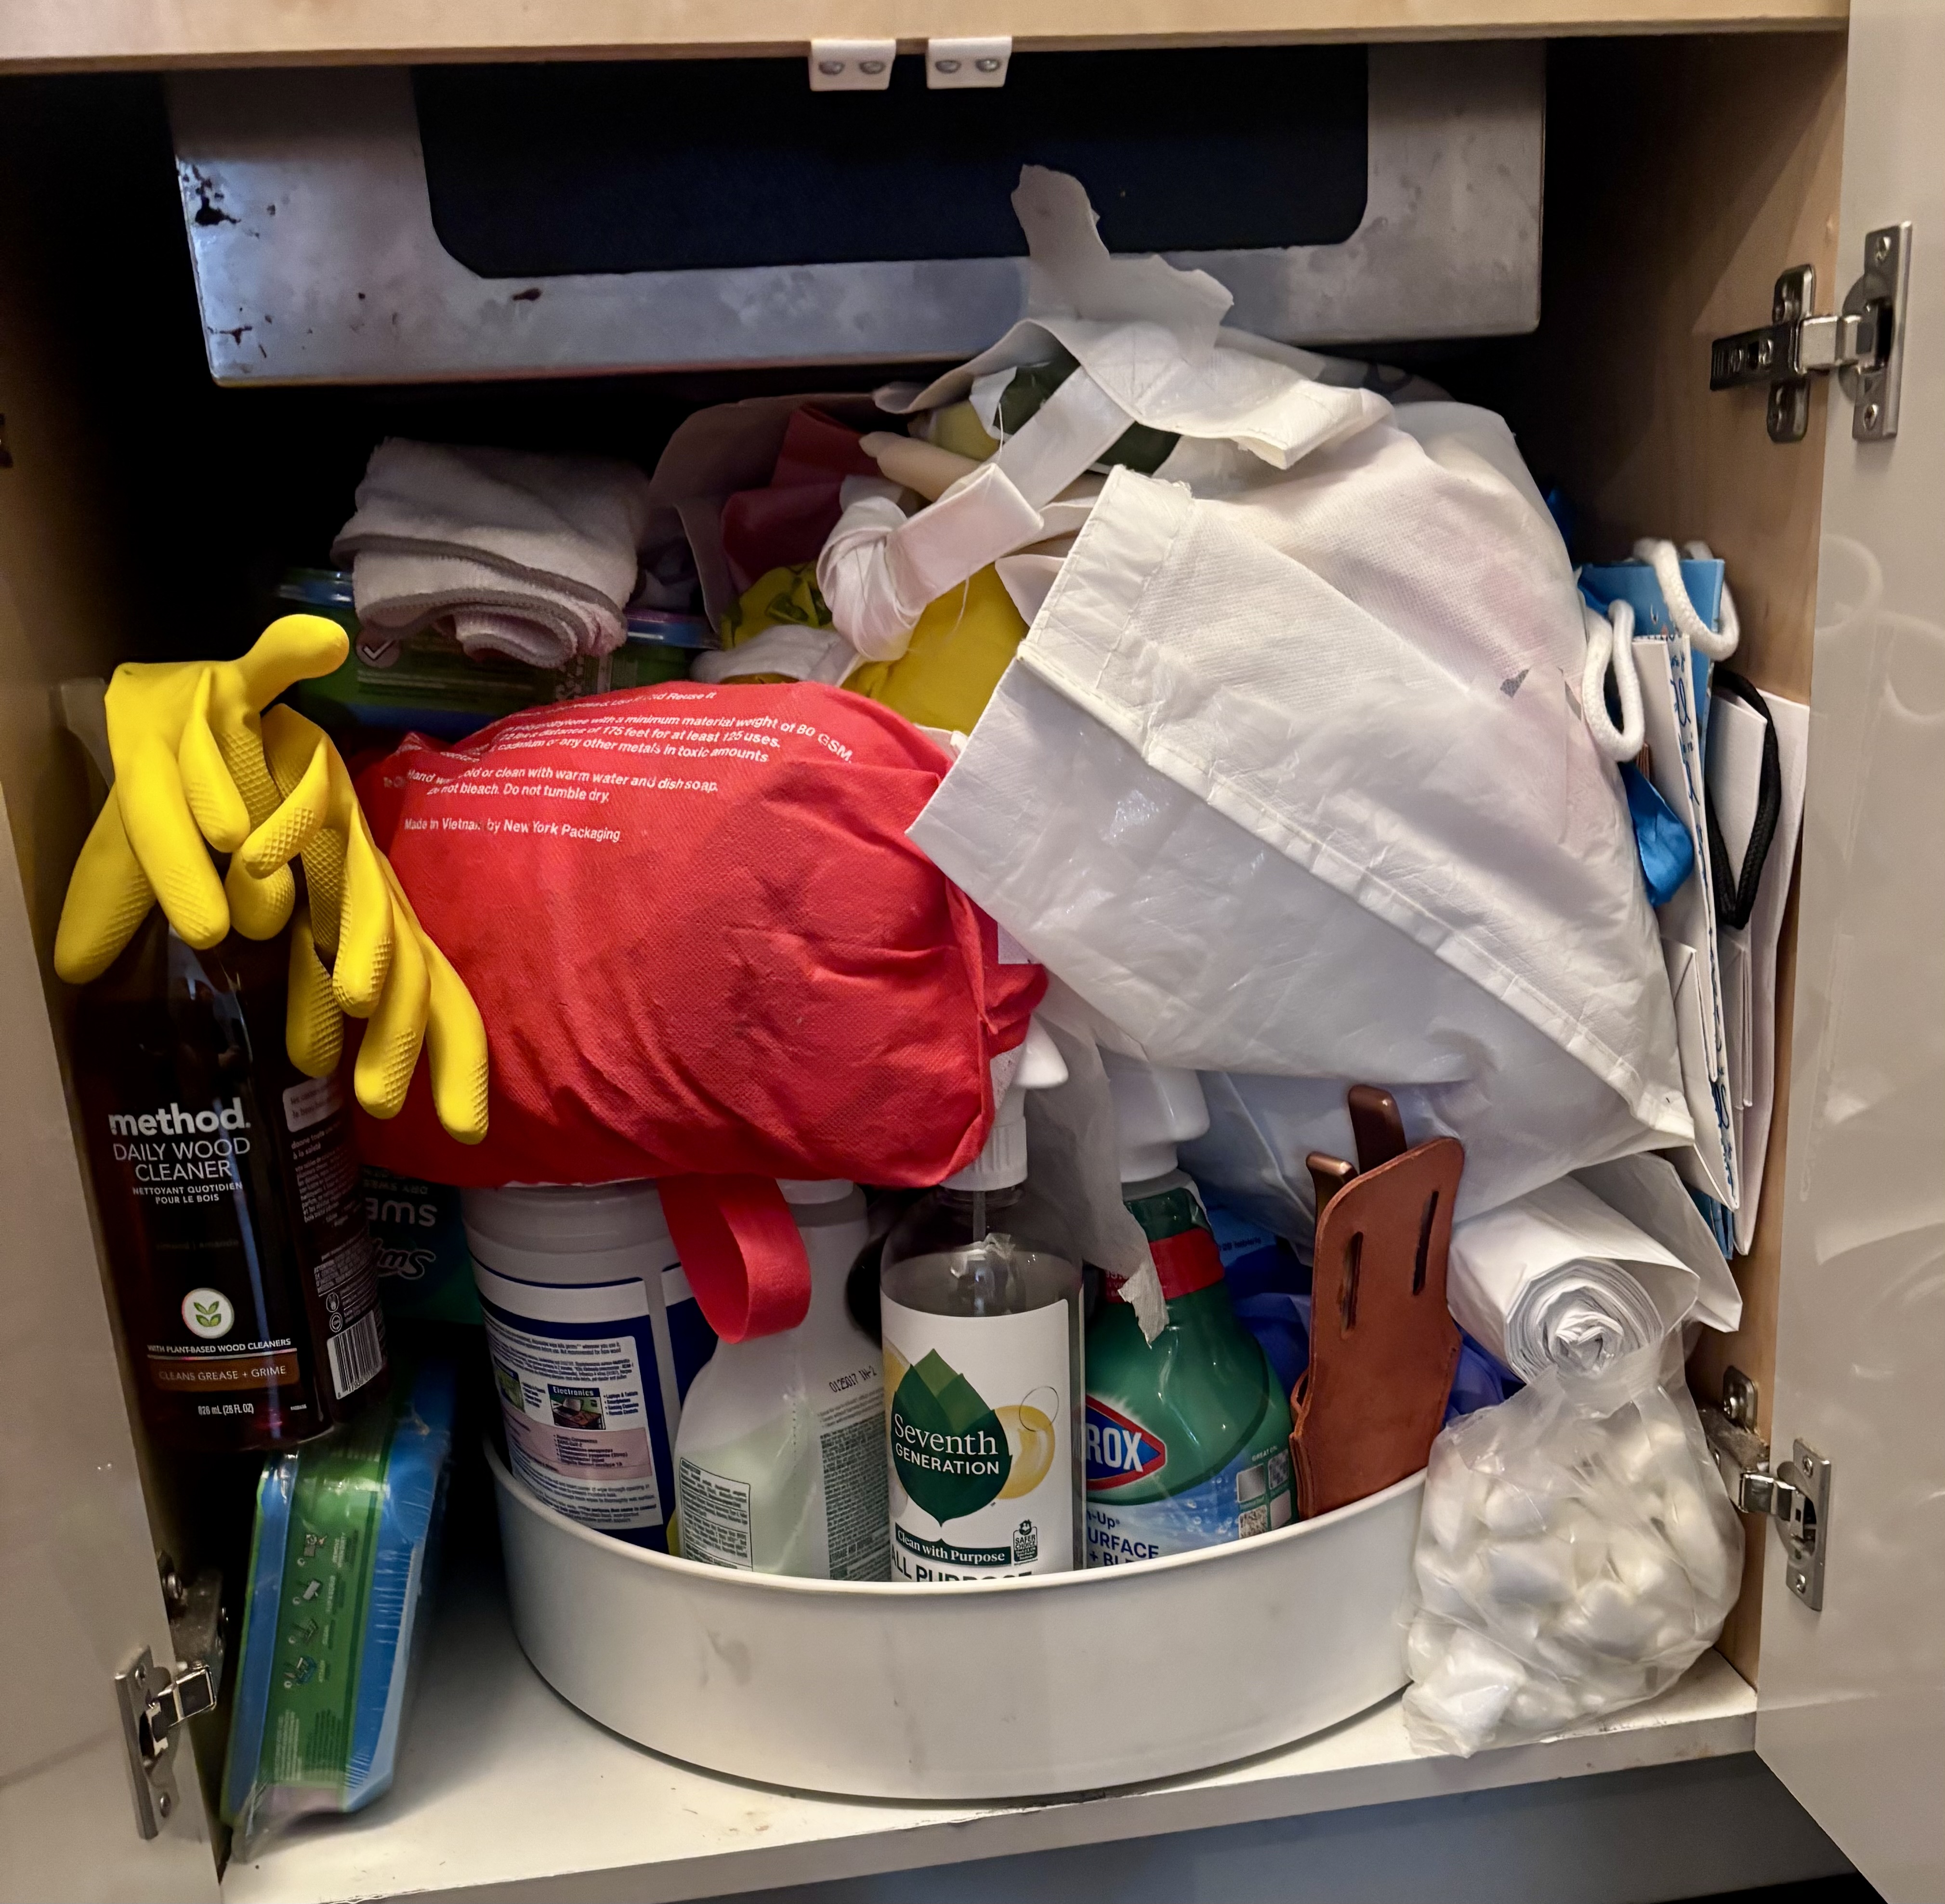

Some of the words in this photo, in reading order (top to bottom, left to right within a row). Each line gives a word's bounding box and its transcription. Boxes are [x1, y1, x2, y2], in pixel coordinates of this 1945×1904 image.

[666, 692, 704, 700] Reuse
[539, 728, 587, 737] distance
[603, 726, 625, 736] 175
[624, 727, 650, 738] feet
[650, 728, 671, 739] for
[671, 730, 686, 740] at
[686, 730, 720, 742] least
[723, 730, 744, 742] 125
[744, 732, 780, 748] uses.
[559, 738, 582, 749] any
[583, 737, 618, 750] other
[618, 742, 660, 755] metals
[663, 745, 675, 755] in
[678, 747, 710, 758] toxic
[591, 716, 616, 724] with
[624, 715, 680, 725] minimum
[682, 716, 736, 727] material
[736, 716, 778, 729] weight
[780, 722, 796, 733] of
[796, 724, 815, 736] 80
[817, 733, 853, 763] GSM.
[482, 769, 493, 777] or
[495, 767, 526, 778] clean
[528, 766, 553, 779] with
[555, 769, 590, 782] warm
[592, 772, 629, 786] water
[630, 775, 657, 788] and
[657, 777, 685, 790] dish
[441, 782, 459, 794] not
[460, 782, 499, 795] bleach.
[503, 783, 519, 795] Do
[521, 784, 542, 796] not
[543, 784, 586, 800] tumble
[588, 788, 609, 803] dry.
[404, 818, 427, 830] Made
[430, 818, 439, 830] in
[487, 817, 500, 834] by
[504, 819, 529, 833] New
[533, 820, 559, 836] York
[561, 823, 621, 843] Packaging
[113, 1142, 166, 1162] DAILY
[171, 1137, 250, 1160] WOOD
[135, 1159, 232, 1182] CLEANER
[132, 1186, 184, 1195] NETTOYANT
[187, 1181, 243, 1194] QUOTIDIEN
[155, 1195, 180, 1205] POUR
[183, 1195, 194, 1203] LE
[197, 1193, 219, 1203] BOIS
[147, 1344, 165, 1352] WITH
[166, 1345, 216, 1353] PLANT-BASED
[217, 1343, 246, 1352] WOOD
[248, 1338, 291, 1350] CLEANERS
[158, 1371, 196, 1381] CLEANS
[198, 1370, 239, 1381] GREASE
[251, 1366, 286, 1378] GRIME
[552, 1386, 594, 1396] Electronics
[243, 1403, 254, 1415] OZ)
[894, 1413, 999, 1457] Seventh
[895, 1442, 999, 1475] GENERATION
[897, 1529, 920, 1552] Clean
[922, 1546, 948, 1560] with
[950, 1549, 1005, 1565] Purpose
[1015, 1534, 1036, 1544] SAFER
